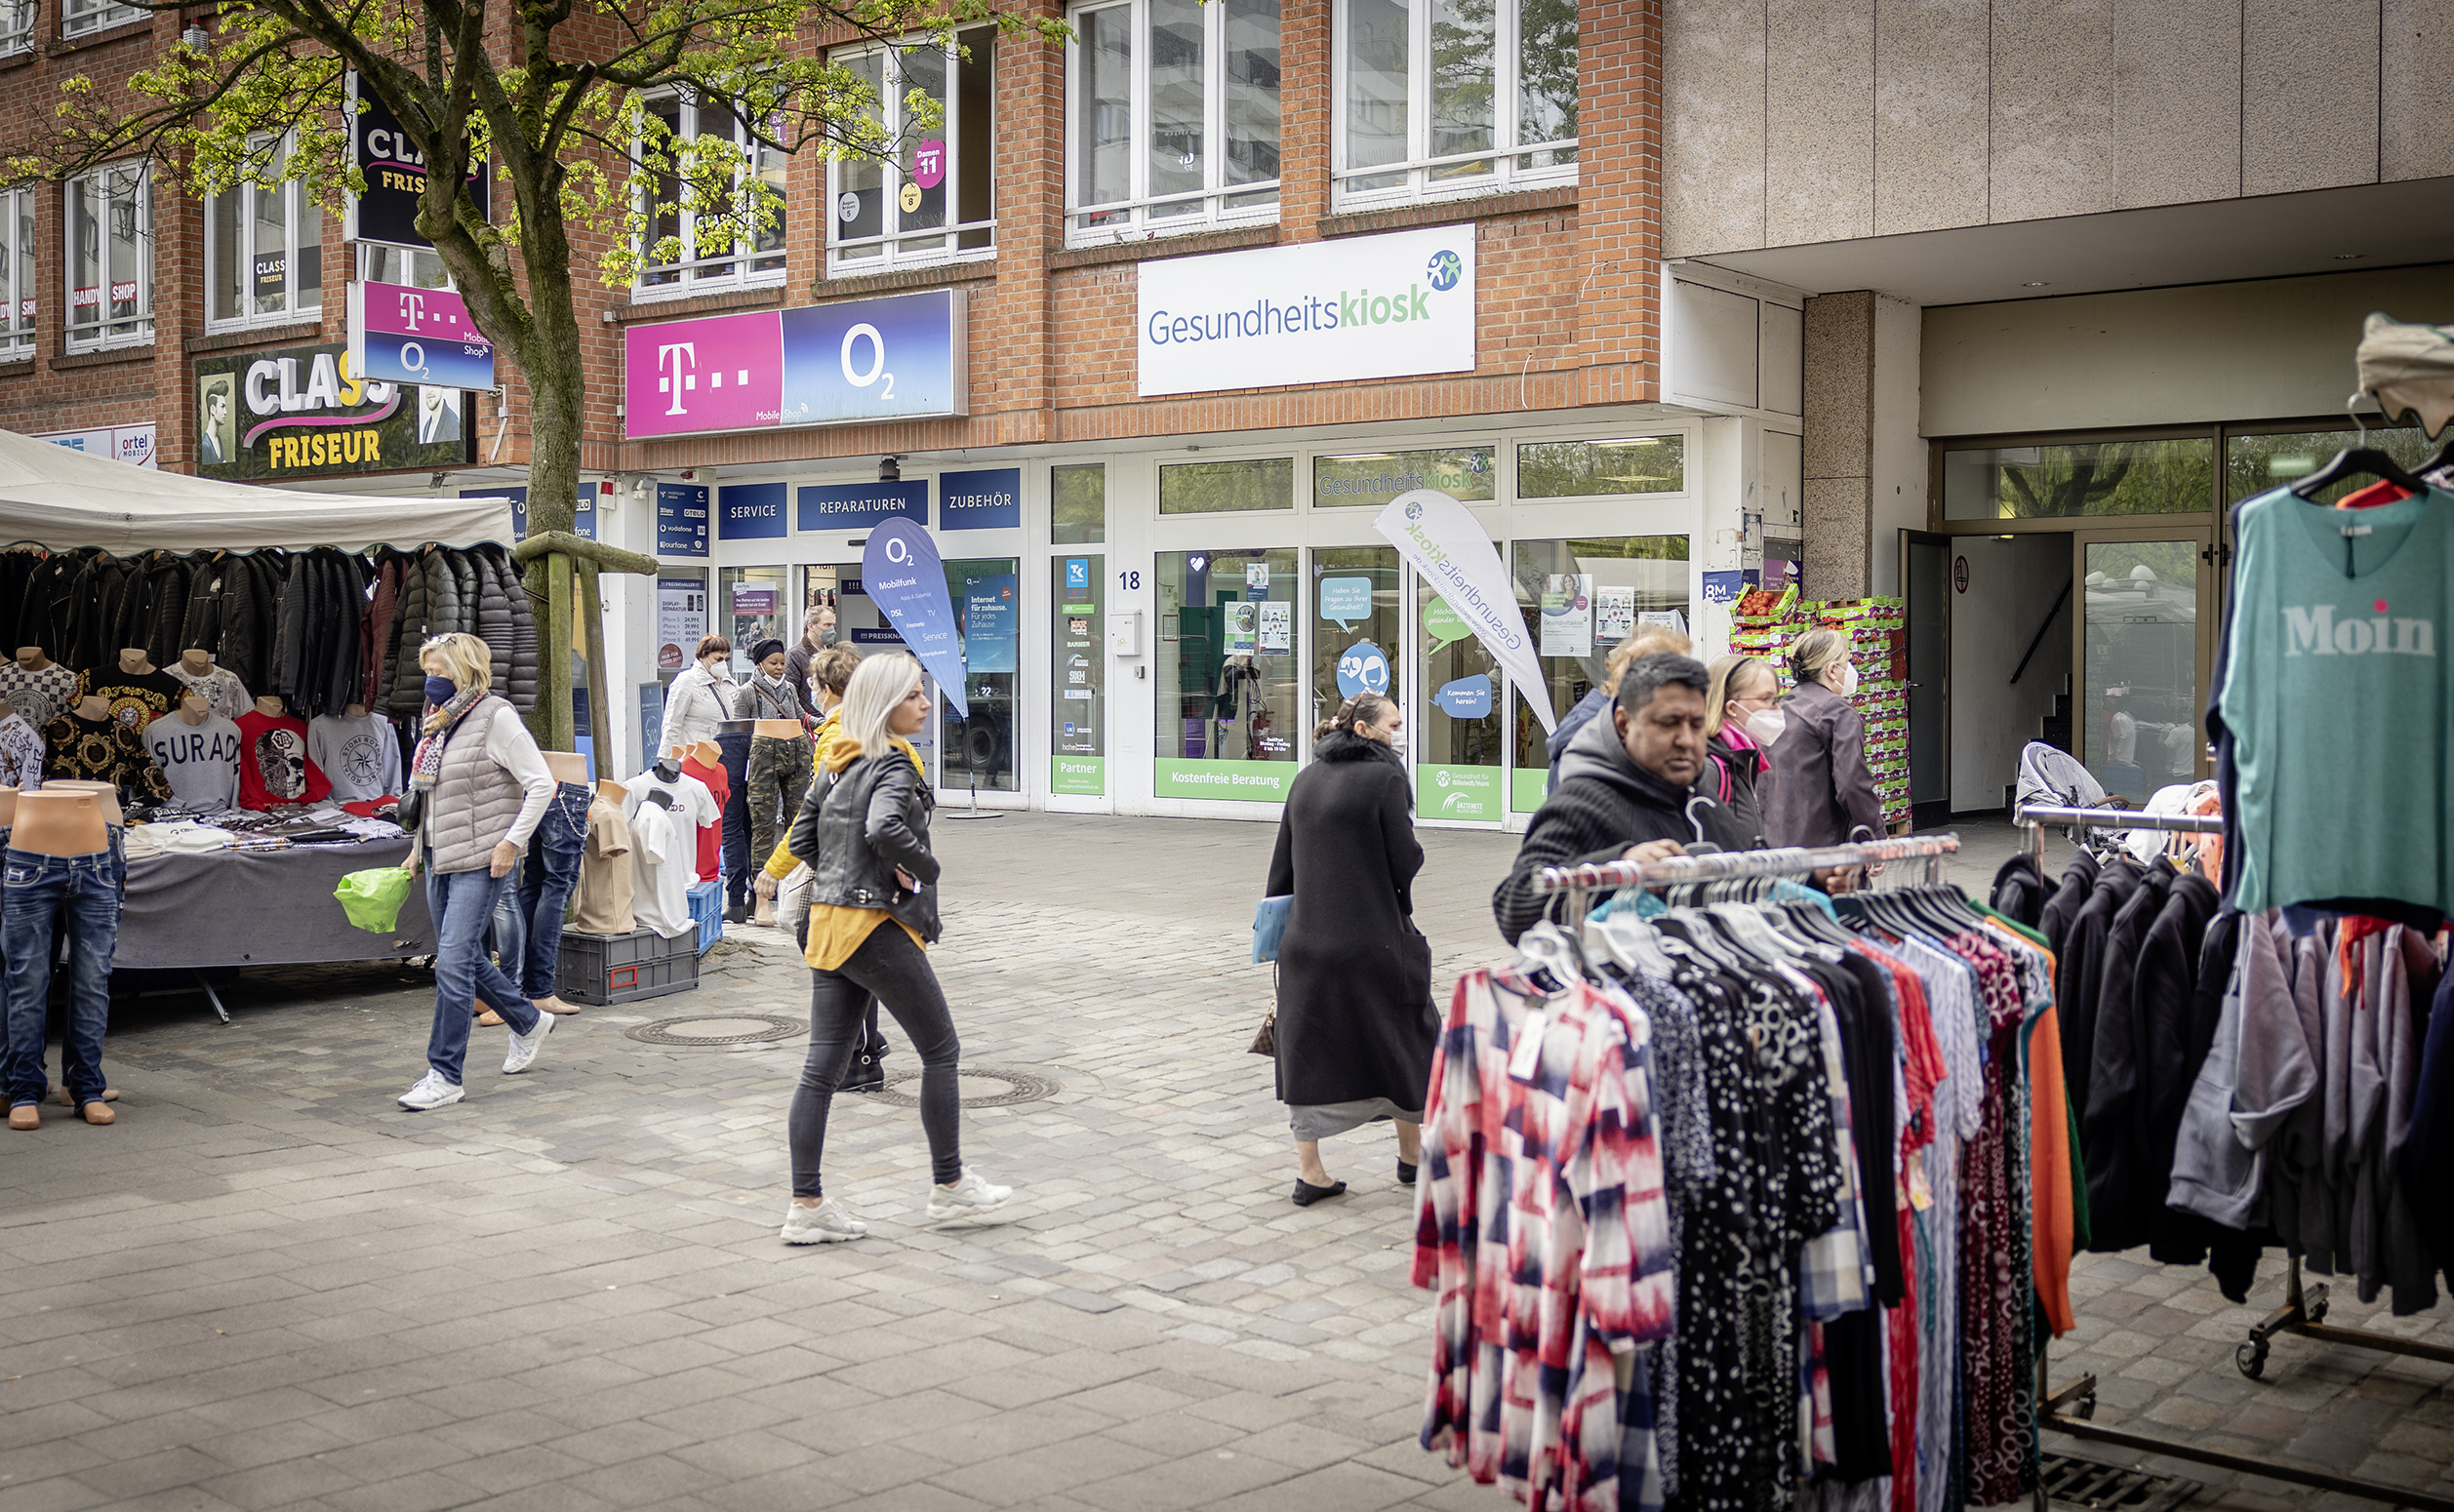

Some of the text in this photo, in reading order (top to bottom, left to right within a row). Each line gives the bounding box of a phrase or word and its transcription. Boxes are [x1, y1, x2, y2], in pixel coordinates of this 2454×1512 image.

[917, 149, 941, 158] Damen
[921, 157, 937, 175] 11
[382, 171, 427, 194] FRIS
[257, 259, 286, 274] CLASS
[261, 274, 283, 284] FRISEUR
[73, 283, 136, 306] HANDY SHOP
[1148, 283, 1430, 345] Gesundheitskiosk
[463, 344, 485, 359] Shop
[755, 408, 802, 421] Mobile Shop
[122, 433, 147, 450] ortel
[268, 429, 381, 469] FRISEUR
[1319, 469, 1473, 496] Gesundheitskiosk
[820, 497, 905, 514] REPARATUREN
[949, 492, 1012, 509] ZUBEHÖR
[731, 504, 777, 518] SERVICE
[885, 537, 914, 566] O2
[879, 577, 917, 590] Mobilfunk
[1119, 571, 1140, 590] 18
[891, 609, 904, 617] DSL
[982, 613, 996, 621] jedes
[1428, 617, 1455, 626] gesünder
[2280, 598, 2435, 657] Moin
[922, 632, 947, 642] Service
[342, 736, 362, 757] STONE
[1061, 762, 1097, 774] Partner
[1172, 772, 1280, 789] Kostenfreie Beratung
[1457, 801, 1483, 810] ÄRZTENETZ
